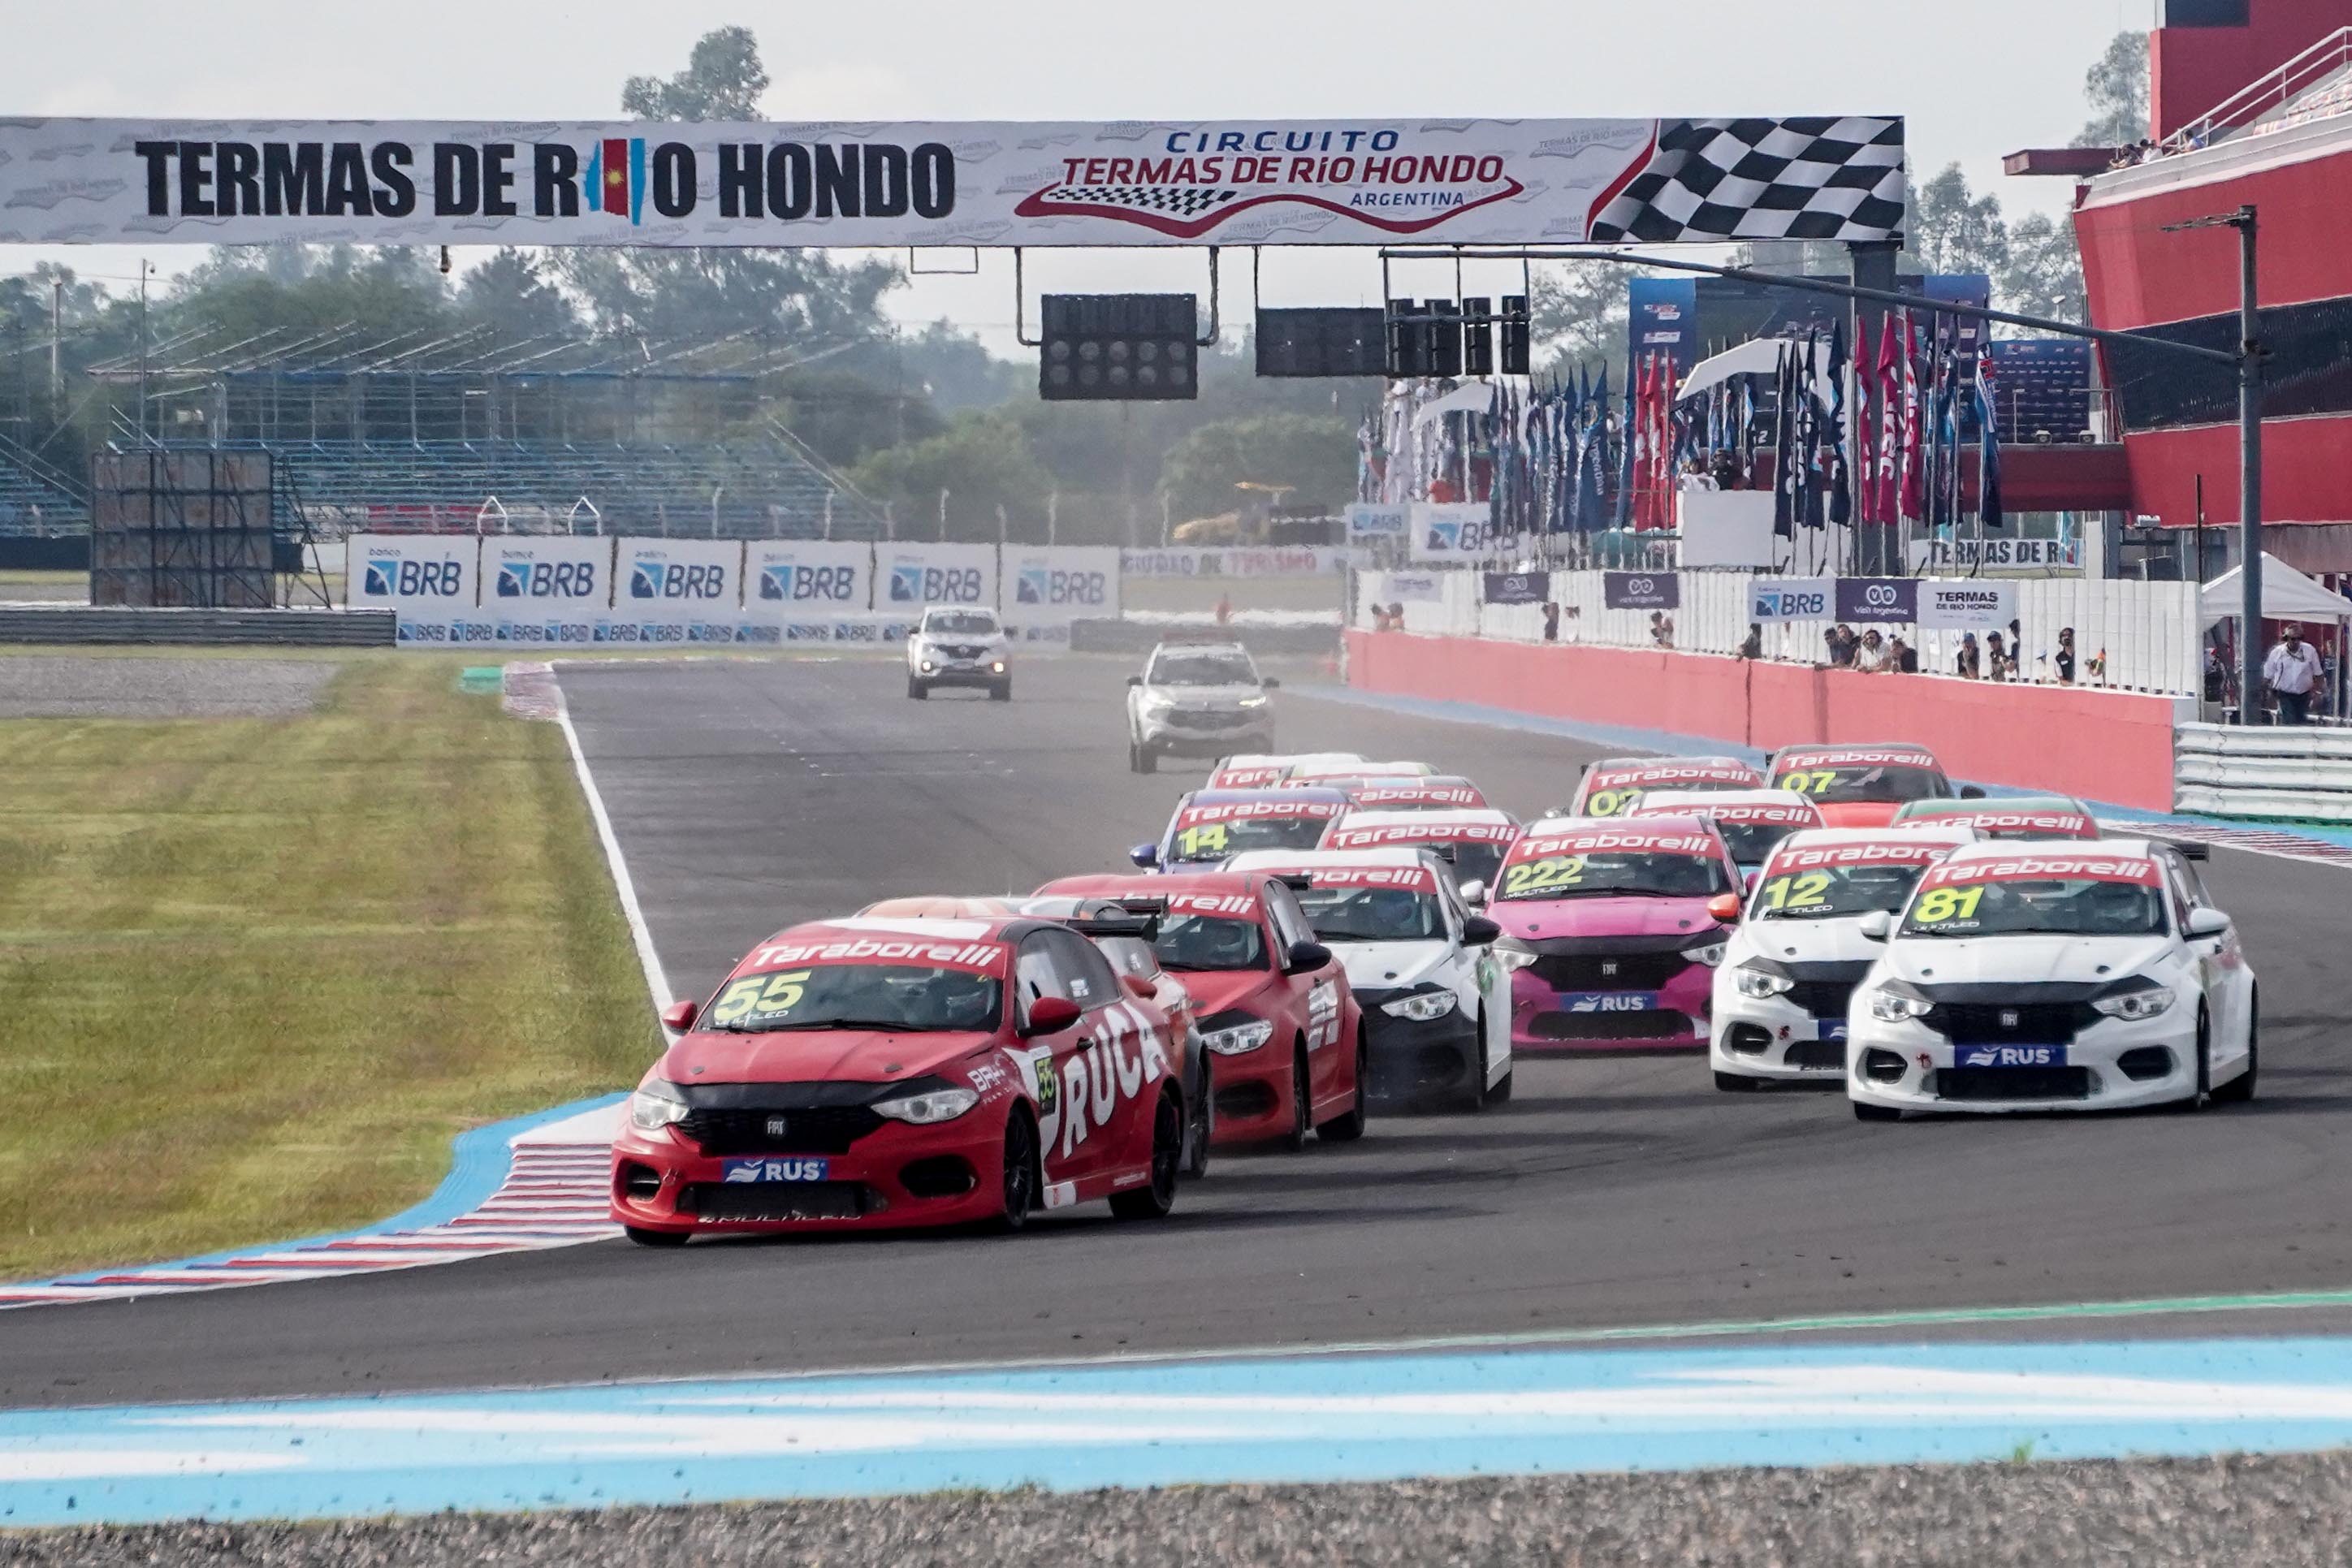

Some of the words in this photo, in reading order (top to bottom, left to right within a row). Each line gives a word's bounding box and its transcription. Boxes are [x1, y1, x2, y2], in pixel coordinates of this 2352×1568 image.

[1166, 130, 1399, 153] CIRCUITO
[136, 140, 417, 218] TERMAS
[435, 143, 517, 218] DE
[719, 142, 954, 219] HONDO
[1063, 156, 1224, 185] TERMAS
[1230, 157, 1282, 184] DE
[1361, 155, 1503, 184] HONDO
[1351, 192, 1464, 207] ARGENTINA
[1929, 541, 2012, 564] TERMAS
[2017, 542, 2041, 563] DE
[399, 561, 462, 596] BRB
[532, 562, 594, 598] BRB
[664, 565, 724, 598] BRB
[793, 566, 855, 601] BRB
[923, 567, 983, 603] BRB
[1050, 571, 1106, 604] BRB
[1781, 593, 1824, 616] BRB
[1936, 592, 1999, 603] TERMAS
[1786, 752, 1934, 767] Taraborelli
[1598, 768, 1751, 787] Taraborelli
[1781, 771, 1836, 793] 07
[1178, 824, 1229, 855] 14
[1334, 825, 1516, 847] Taraborelli
[1522, 835, 1712, 856] Taraborelli
[1506, 857, 1584, 894] 222
[1934, 859, 2151, 884] Taraborelli
[1765, 874, 1830, 909] 12
[1917, 887, 1985, 922] 81
[754, 940, 1001, 967] Taraborelli
[714, 970, 812, 1021] 55
[1602, 996, 1645, 1011] RUS
[2001, 1048, 2051, 1065] RUS
[765, 1161, 820, 1181] RUS
